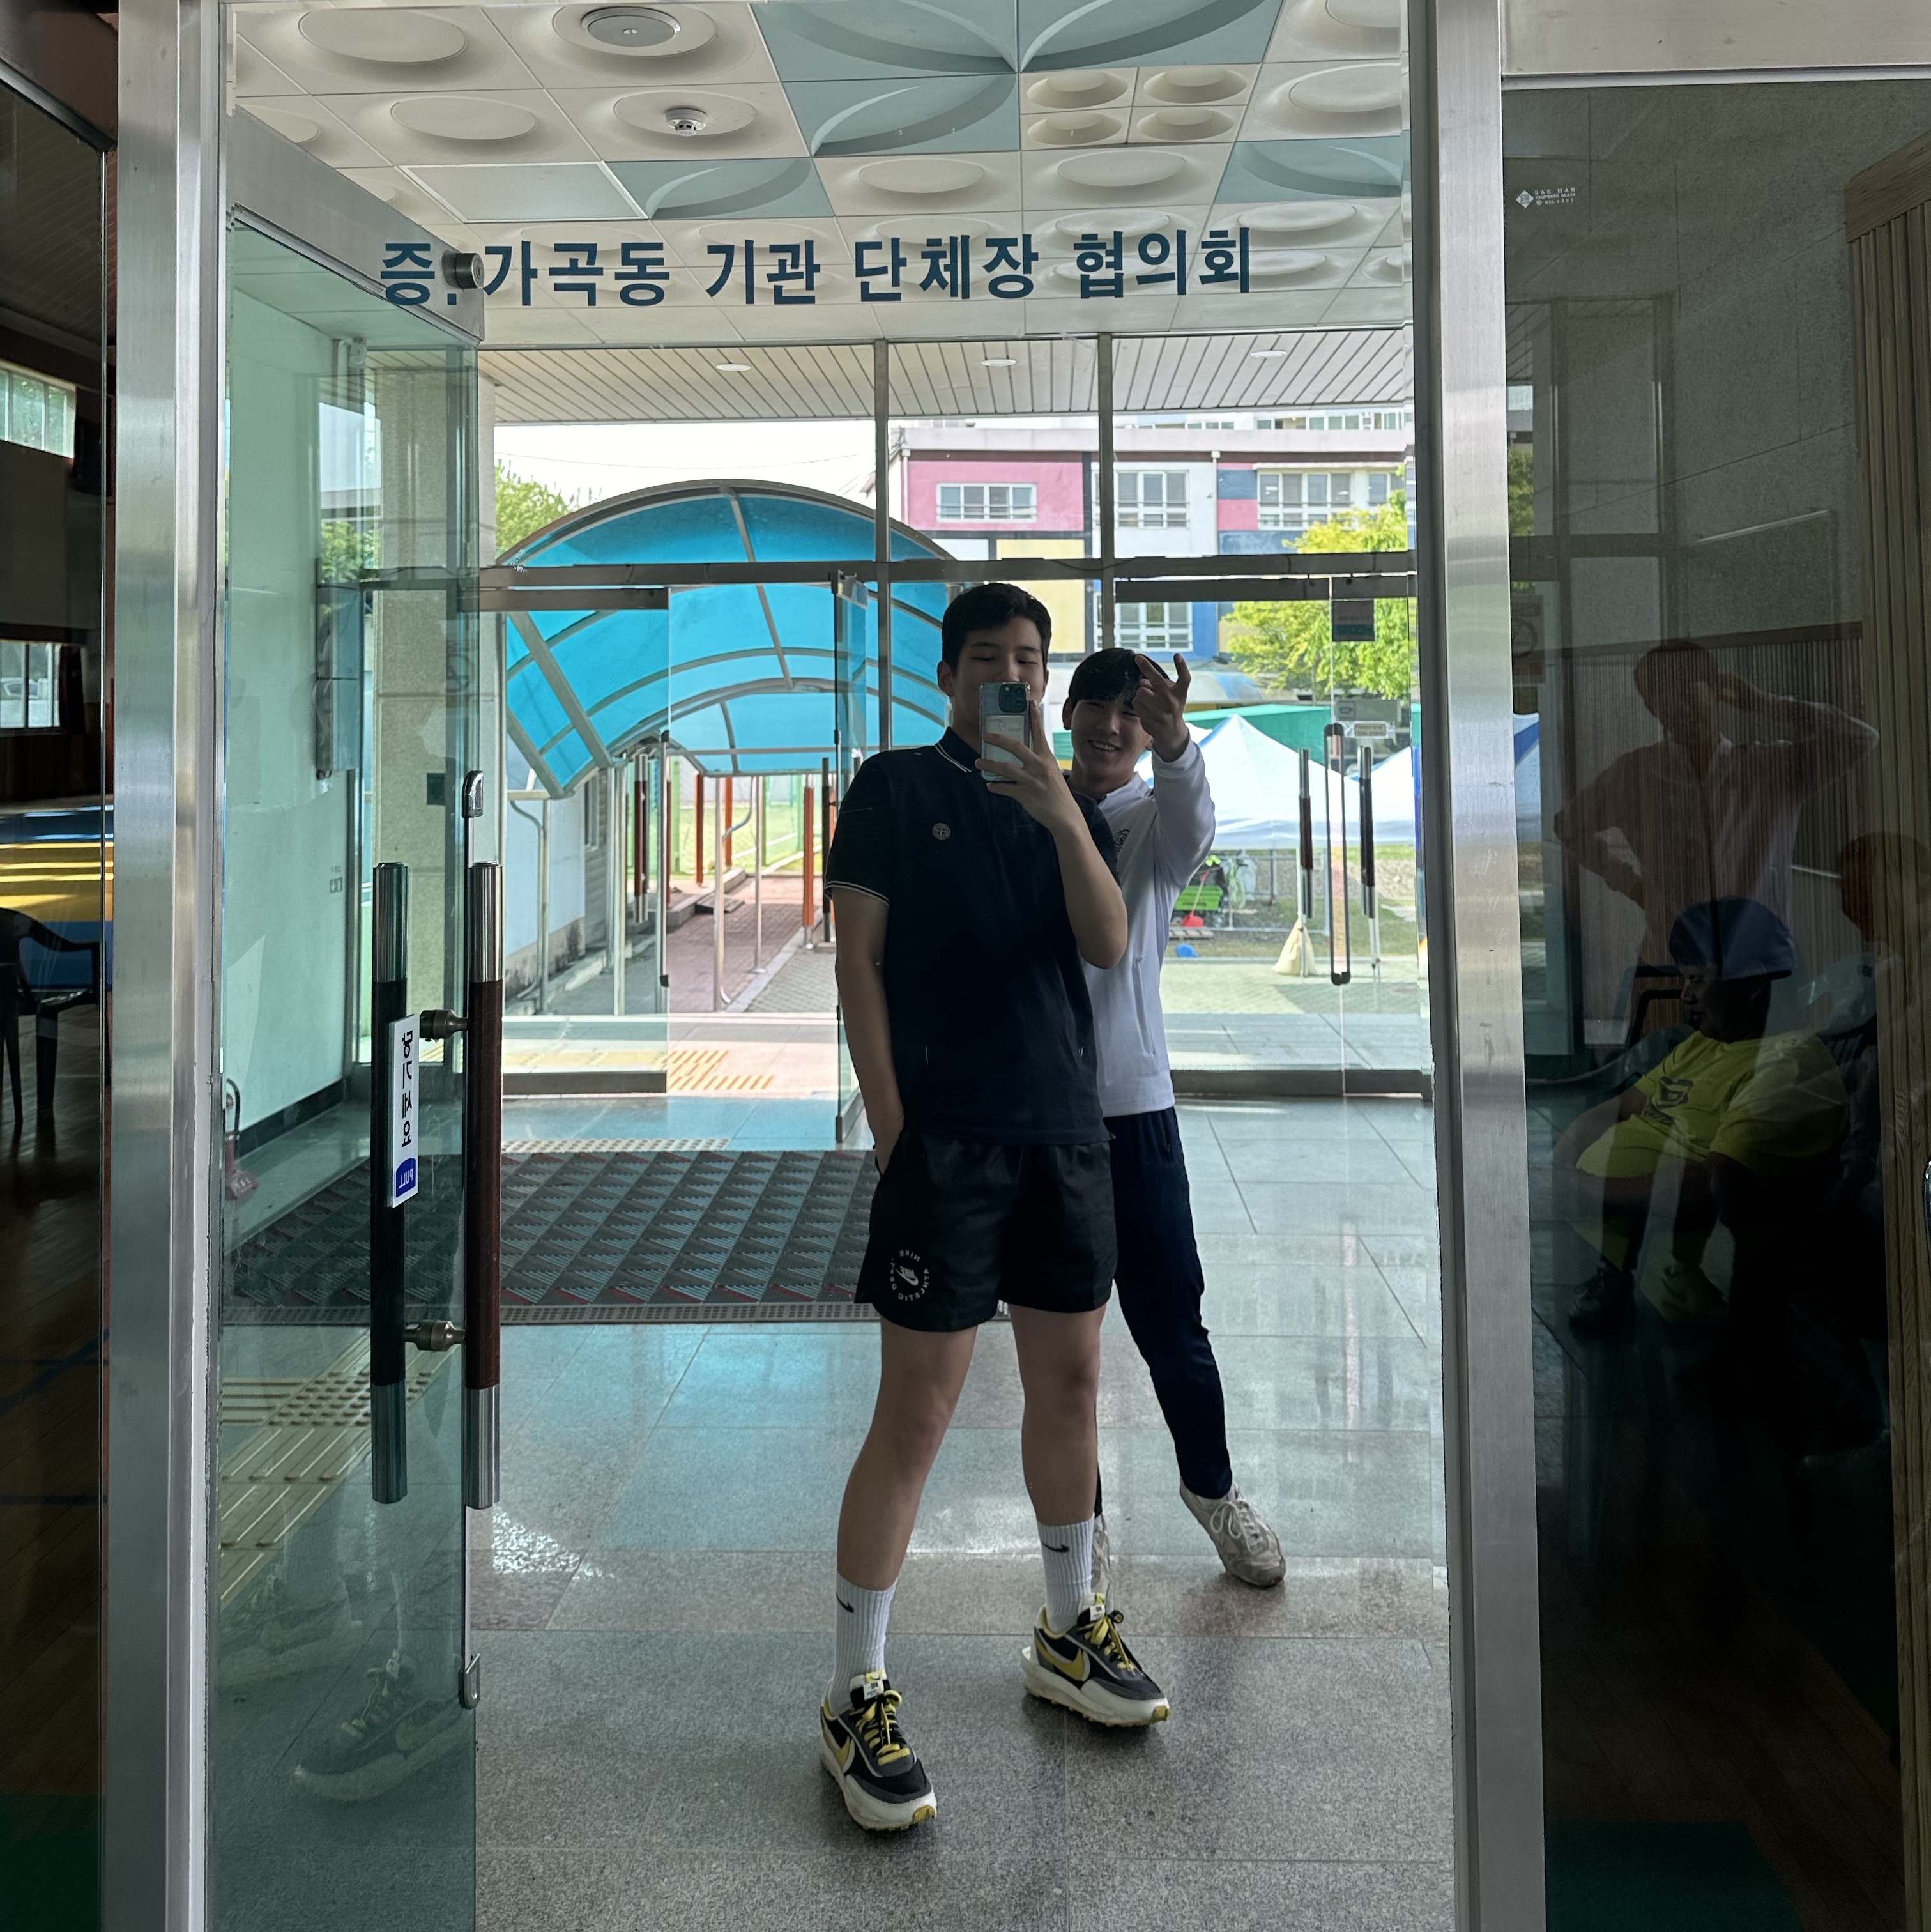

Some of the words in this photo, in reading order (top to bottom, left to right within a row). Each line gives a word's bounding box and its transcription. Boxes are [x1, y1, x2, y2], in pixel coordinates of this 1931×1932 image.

[484, 240, 671, 306] 가곡동
[706, 239, 820, 305] 기관
[855, 233, 1039, 302] 단체장
[1072, 227, 1250, 299] 협의회
